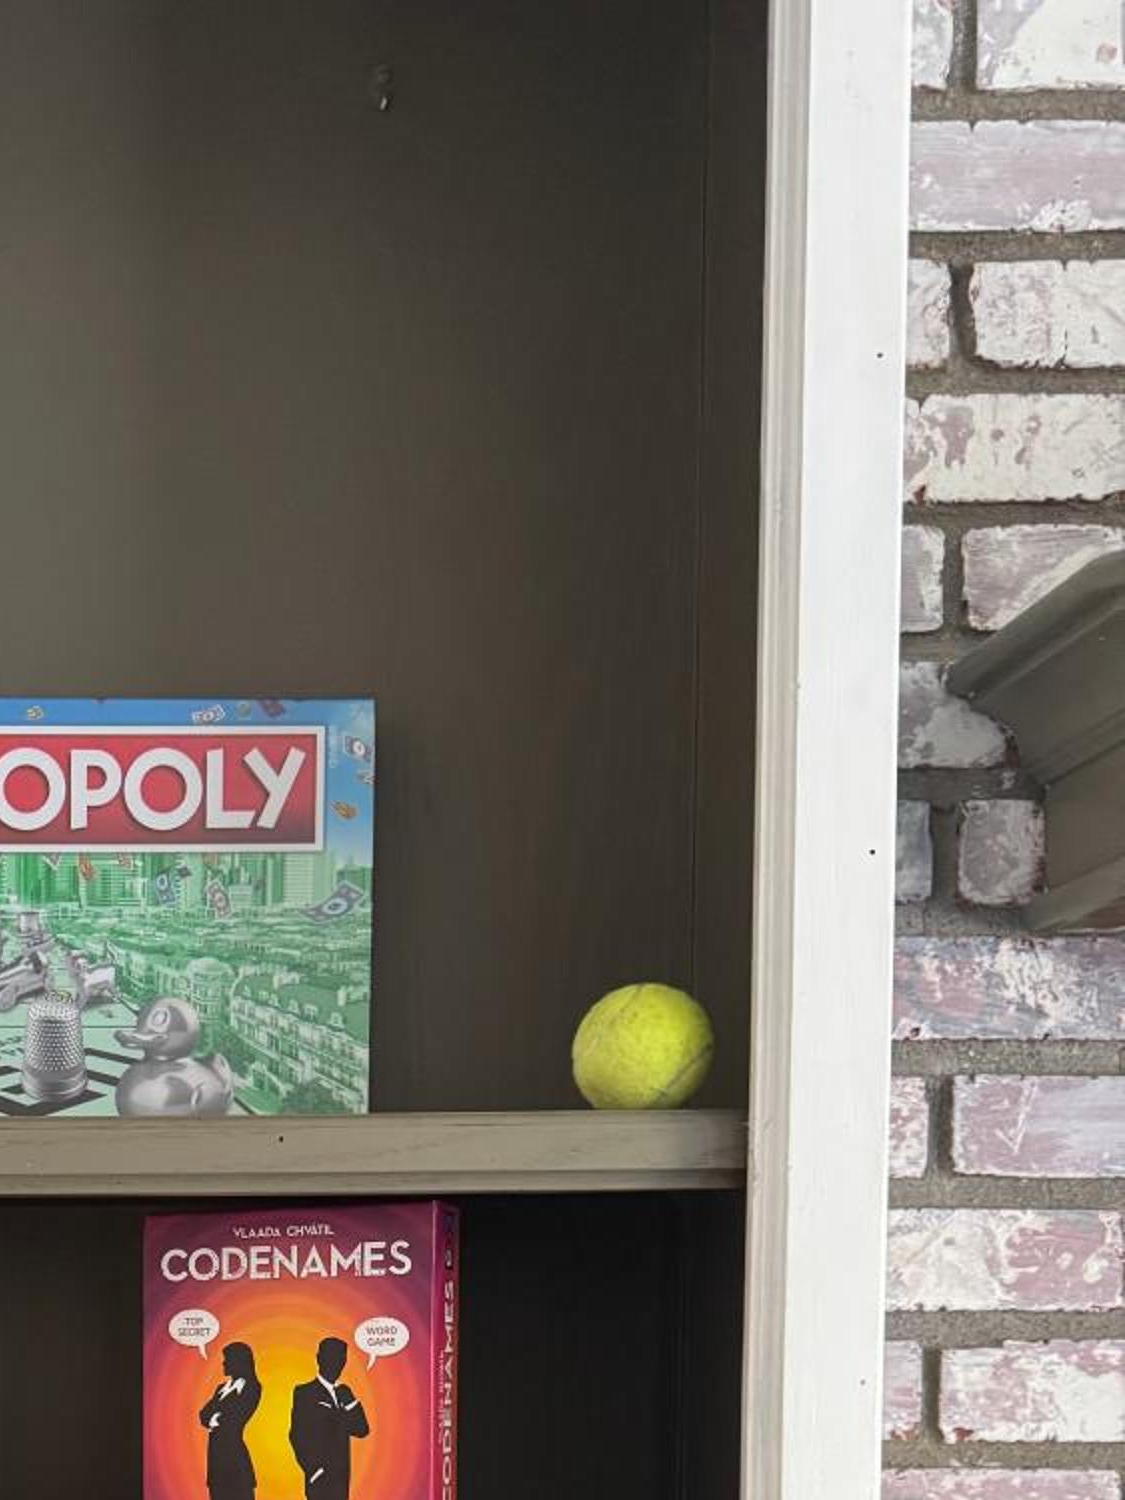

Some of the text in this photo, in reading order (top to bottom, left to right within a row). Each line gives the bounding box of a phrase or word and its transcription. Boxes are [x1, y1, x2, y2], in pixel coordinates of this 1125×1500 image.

[160, 1240, 413, 1282] CODENAMES
[366, 1325, 398, 1335] WORD
[366, 1337, 396, 1346] GAME
